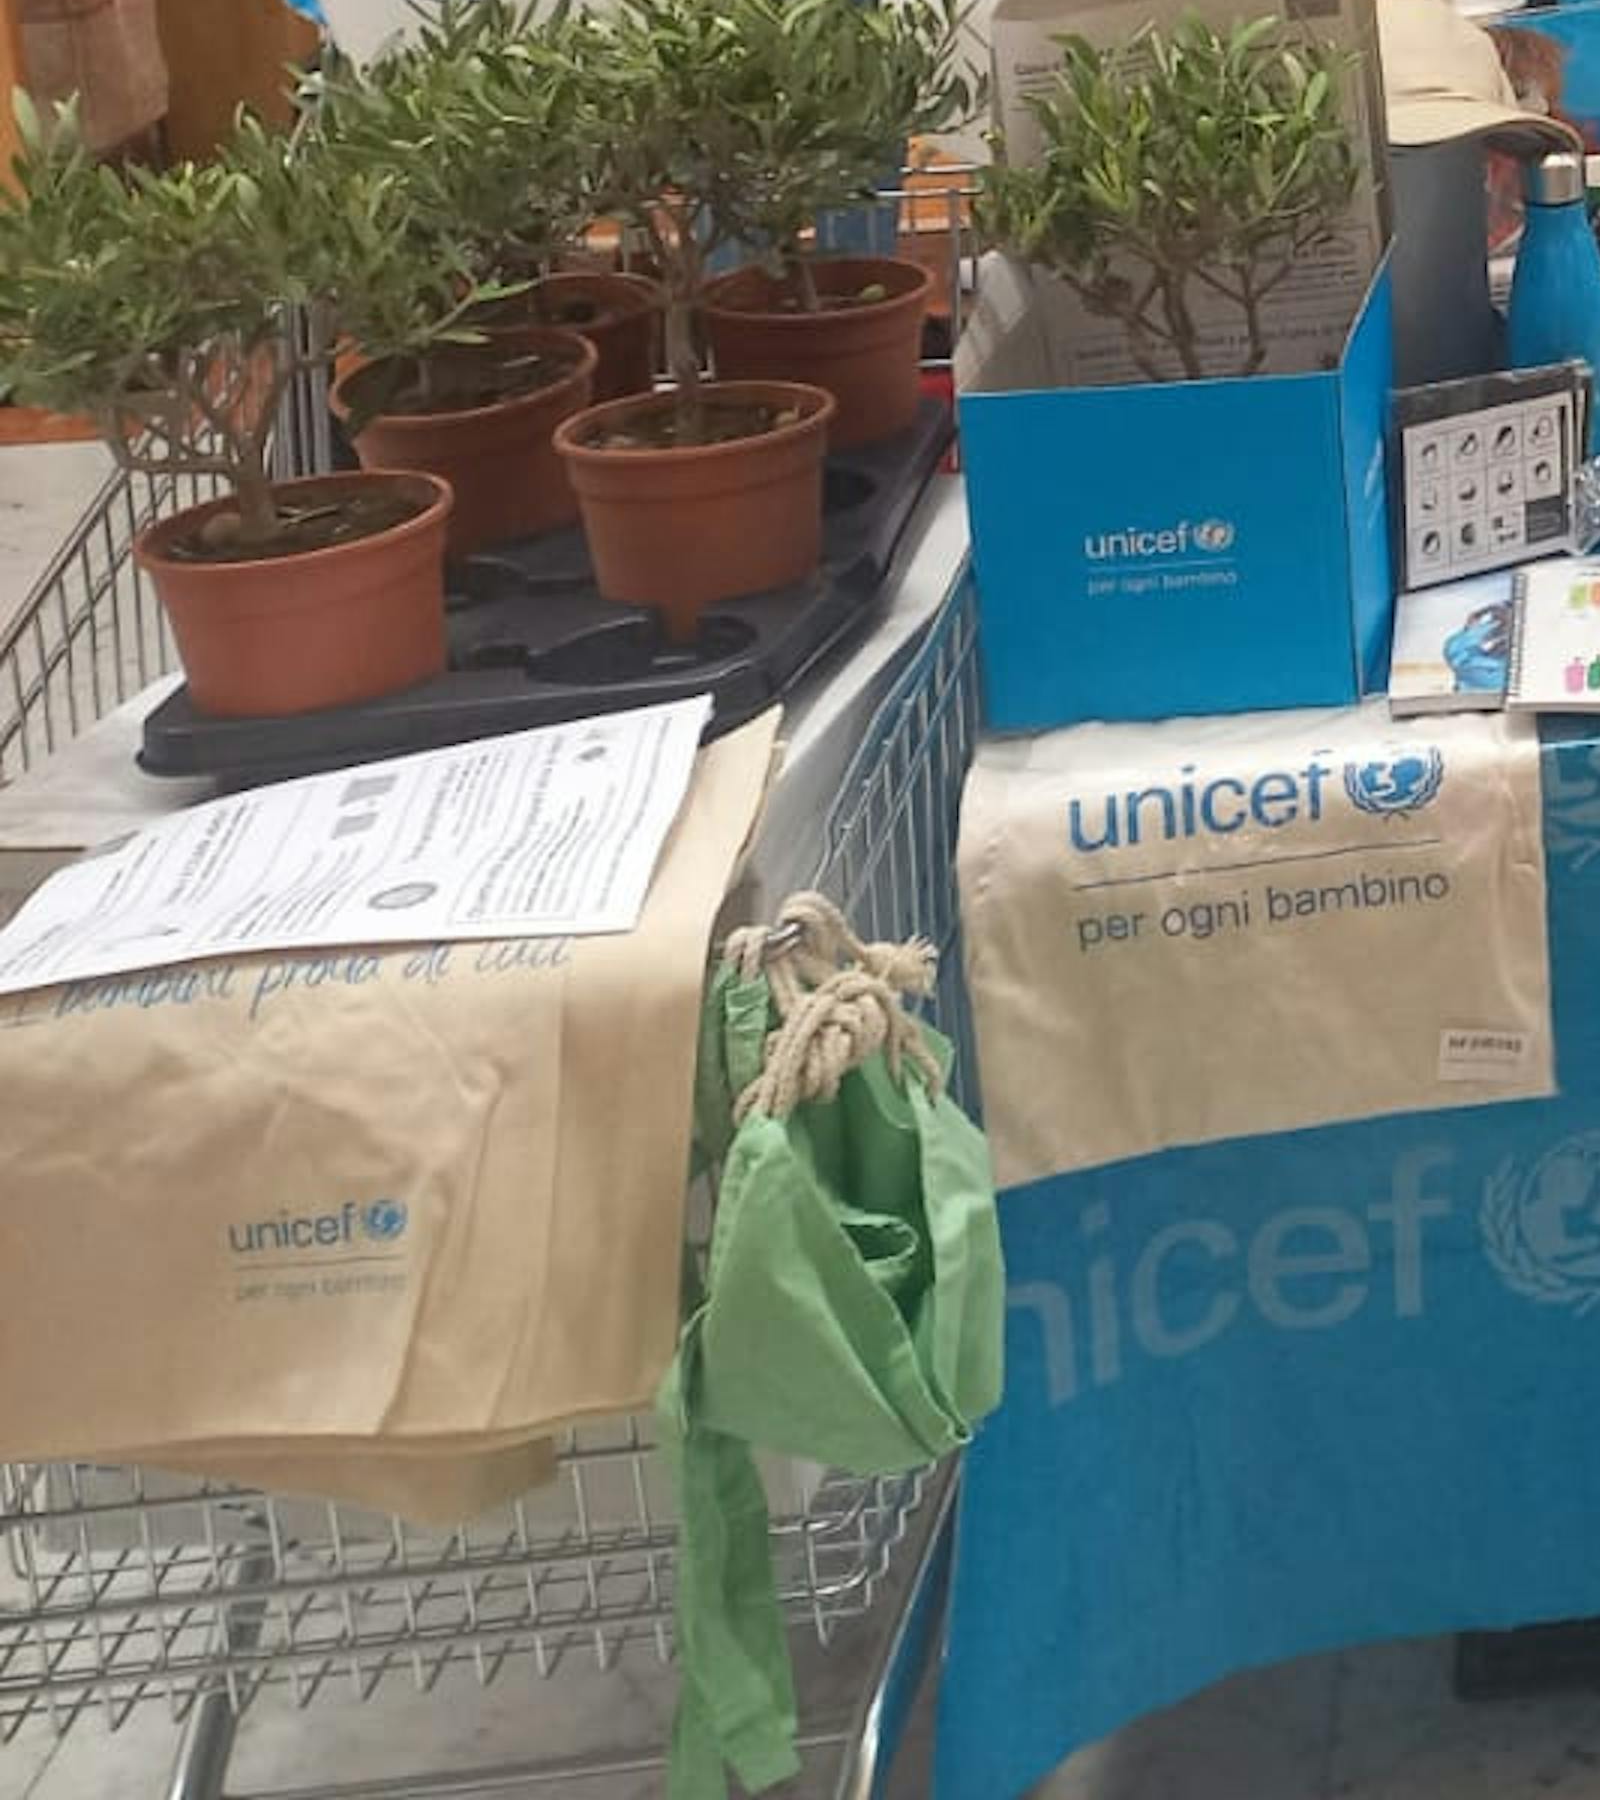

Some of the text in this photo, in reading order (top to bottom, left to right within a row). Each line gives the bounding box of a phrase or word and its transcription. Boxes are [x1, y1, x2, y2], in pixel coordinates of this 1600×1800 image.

[1084, 522, 1188, 561] unicef
[1068, 748, 1333, 854] unicef
[1077, 868, 1451, 953] per ogni bambino
[228, 1201, 357, 1254] unicef
